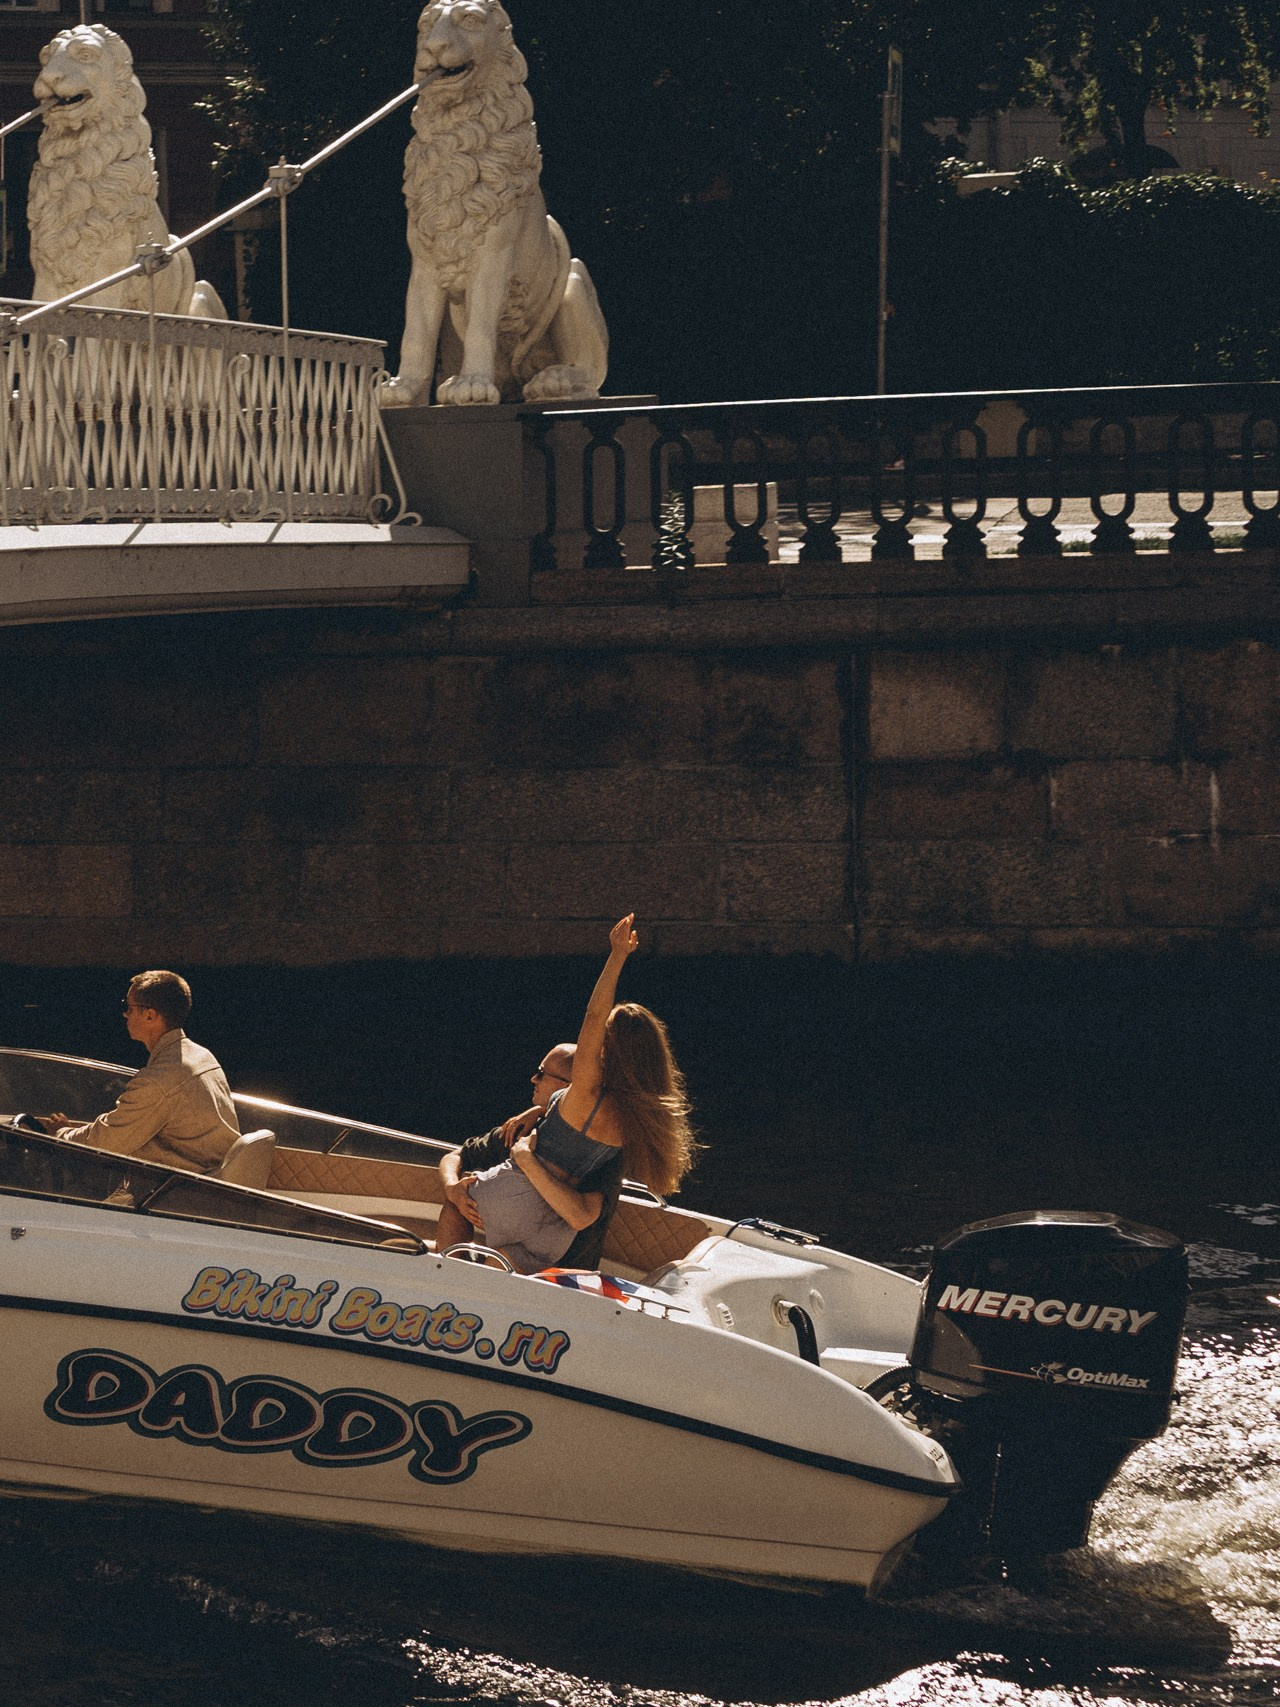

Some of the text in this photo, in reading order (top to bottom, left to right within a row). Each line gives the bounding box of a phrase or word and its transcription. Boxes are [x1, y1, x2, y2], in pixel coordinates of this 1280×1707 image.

[182, 1266, 571, 1375] Bikini Boats.ru
[937, 1284, 1157, 1335] MERCURY
[43, 1348, 533, 1485] DADDY
[1066, 1367, 1150, 1390] OptiMax
